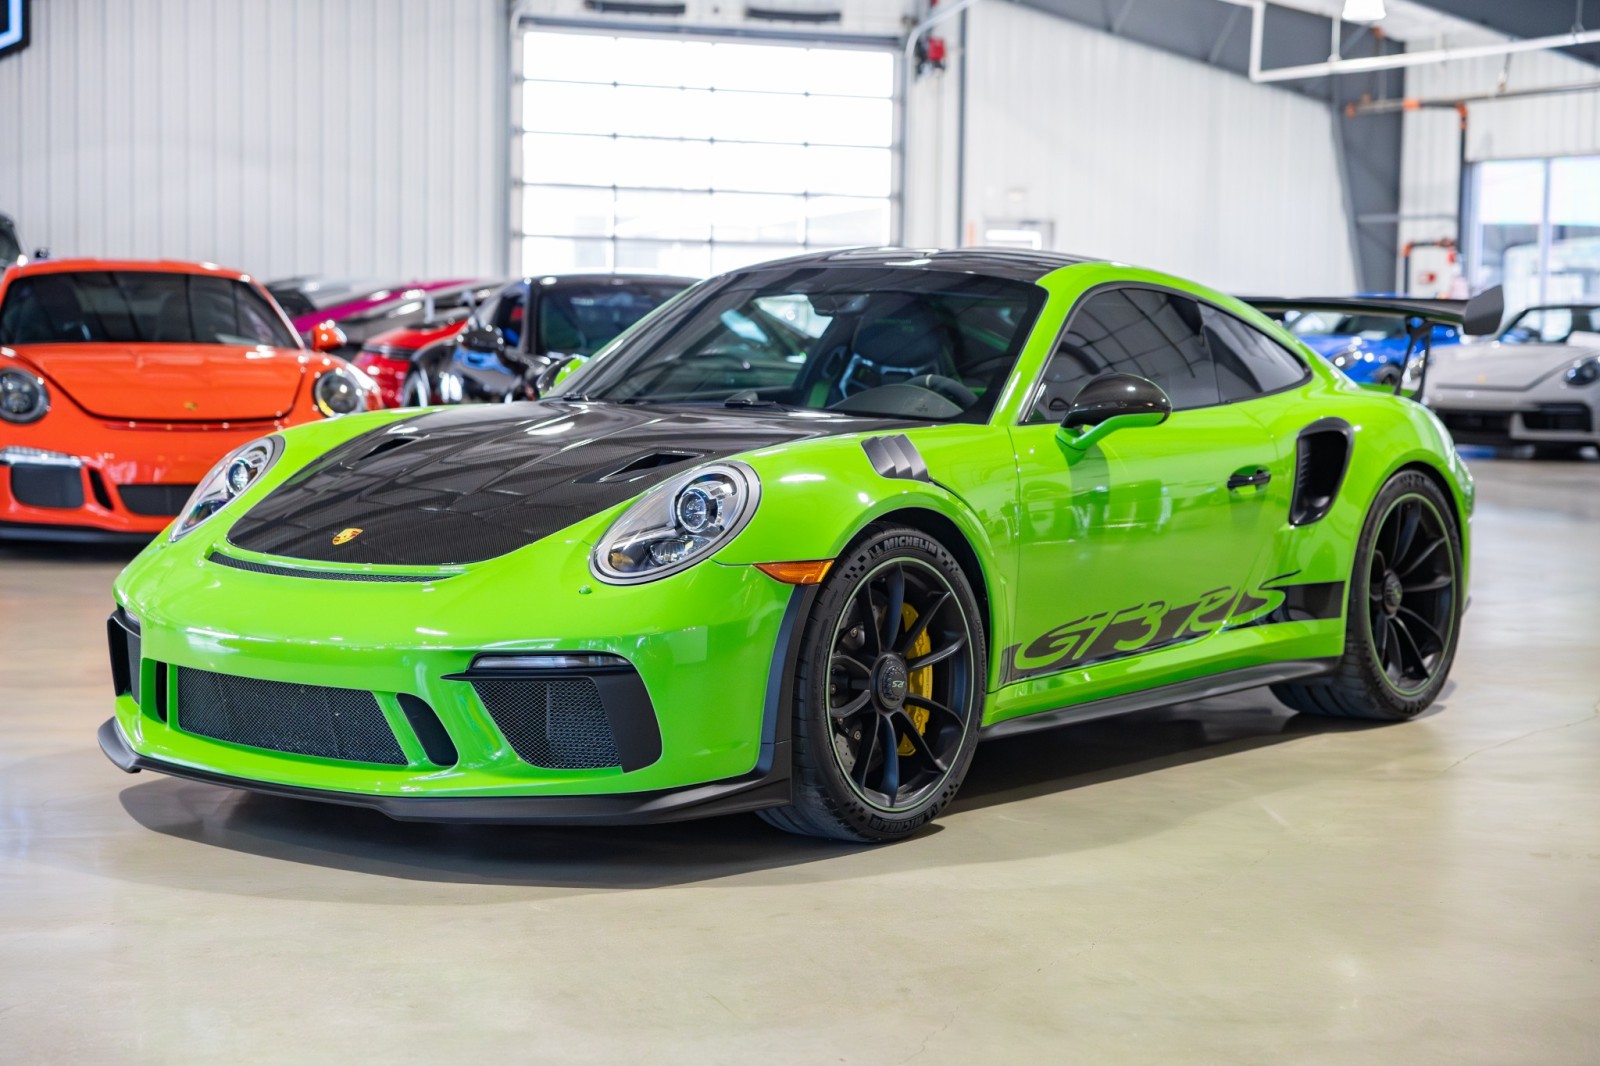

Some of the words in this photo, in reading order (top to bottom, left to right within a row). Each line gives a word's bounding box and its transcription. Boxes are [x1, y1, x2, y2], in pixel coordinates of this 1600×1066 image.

[884, 536, 937, 555] MICHELIN
[1014, 600, 1171, 669] GT3
[1174, 570, 1302, 638] RS
